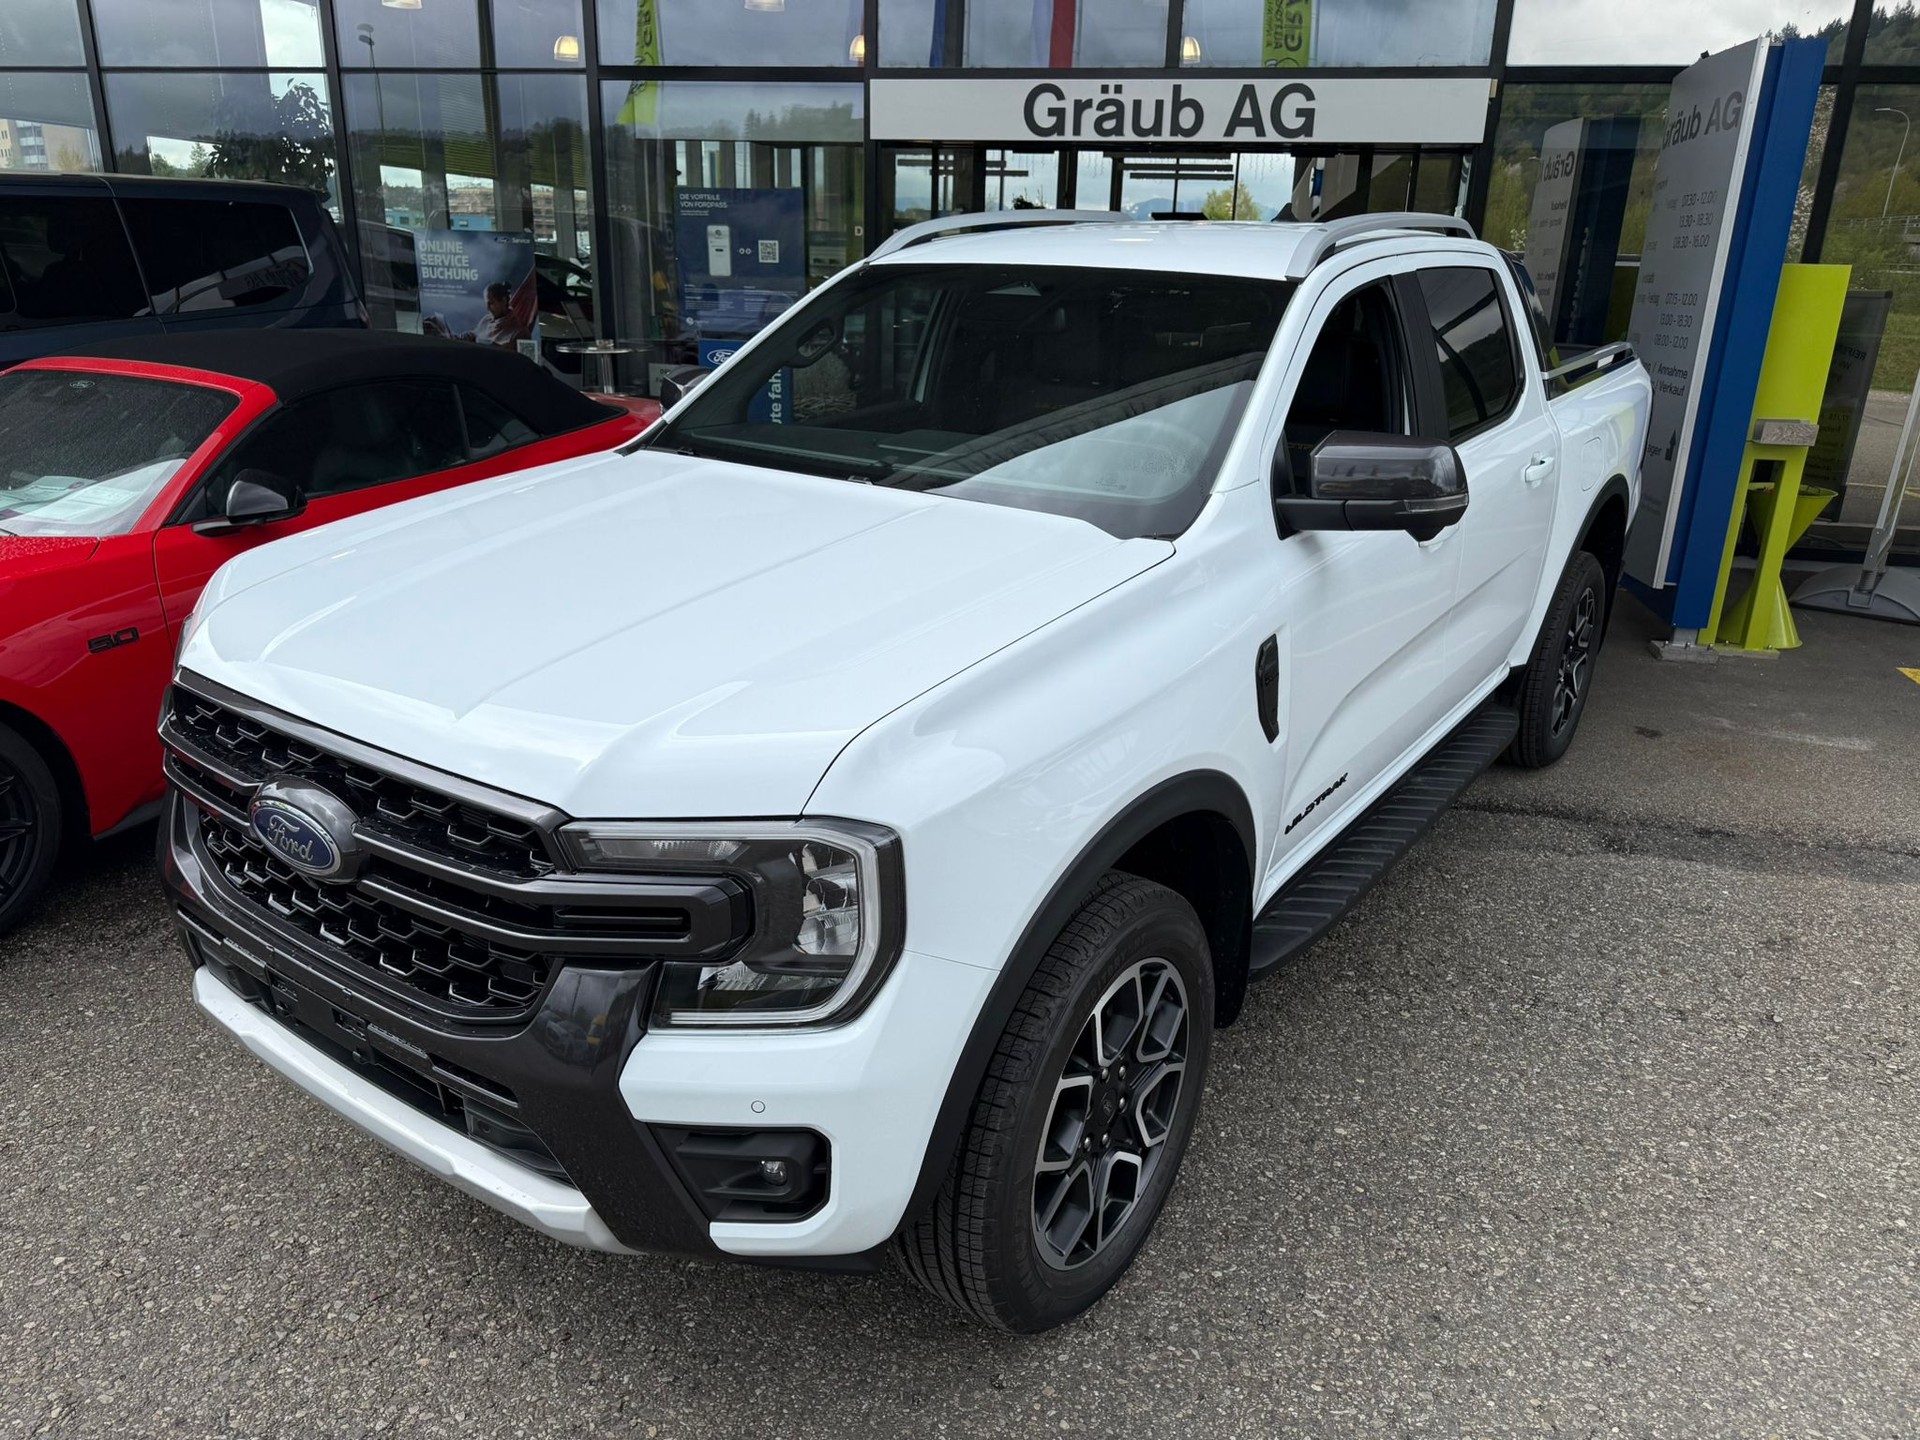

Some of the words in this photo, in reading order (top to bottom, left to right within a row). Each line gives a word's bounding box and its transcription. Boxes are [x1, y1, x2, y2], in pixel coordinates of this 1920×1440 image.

[1024, 83, 1204, 138] Gräub
[1224, 82, 1316, 139] AG
[1704, 90, 1744, 136] AG
[690, 193, 721, 201] VORTEILE
[418, 240, 463, 254] ONLINE
[420, 253, 470, 267] SERVICE
[421, 267, 479, 281] BUCHUNG
[1658, 363, 1688, 379] Annahme
[768, 367, 782, 400] fah
[1659, 380, 1686, 397] Verkauf
[1647, 444, 1662, 457] ager
[87, 626, 140, 654] 5.0
[1284, 772, 1349, 835] WILDTRAK
[268, 814, 314, 862] Ford
